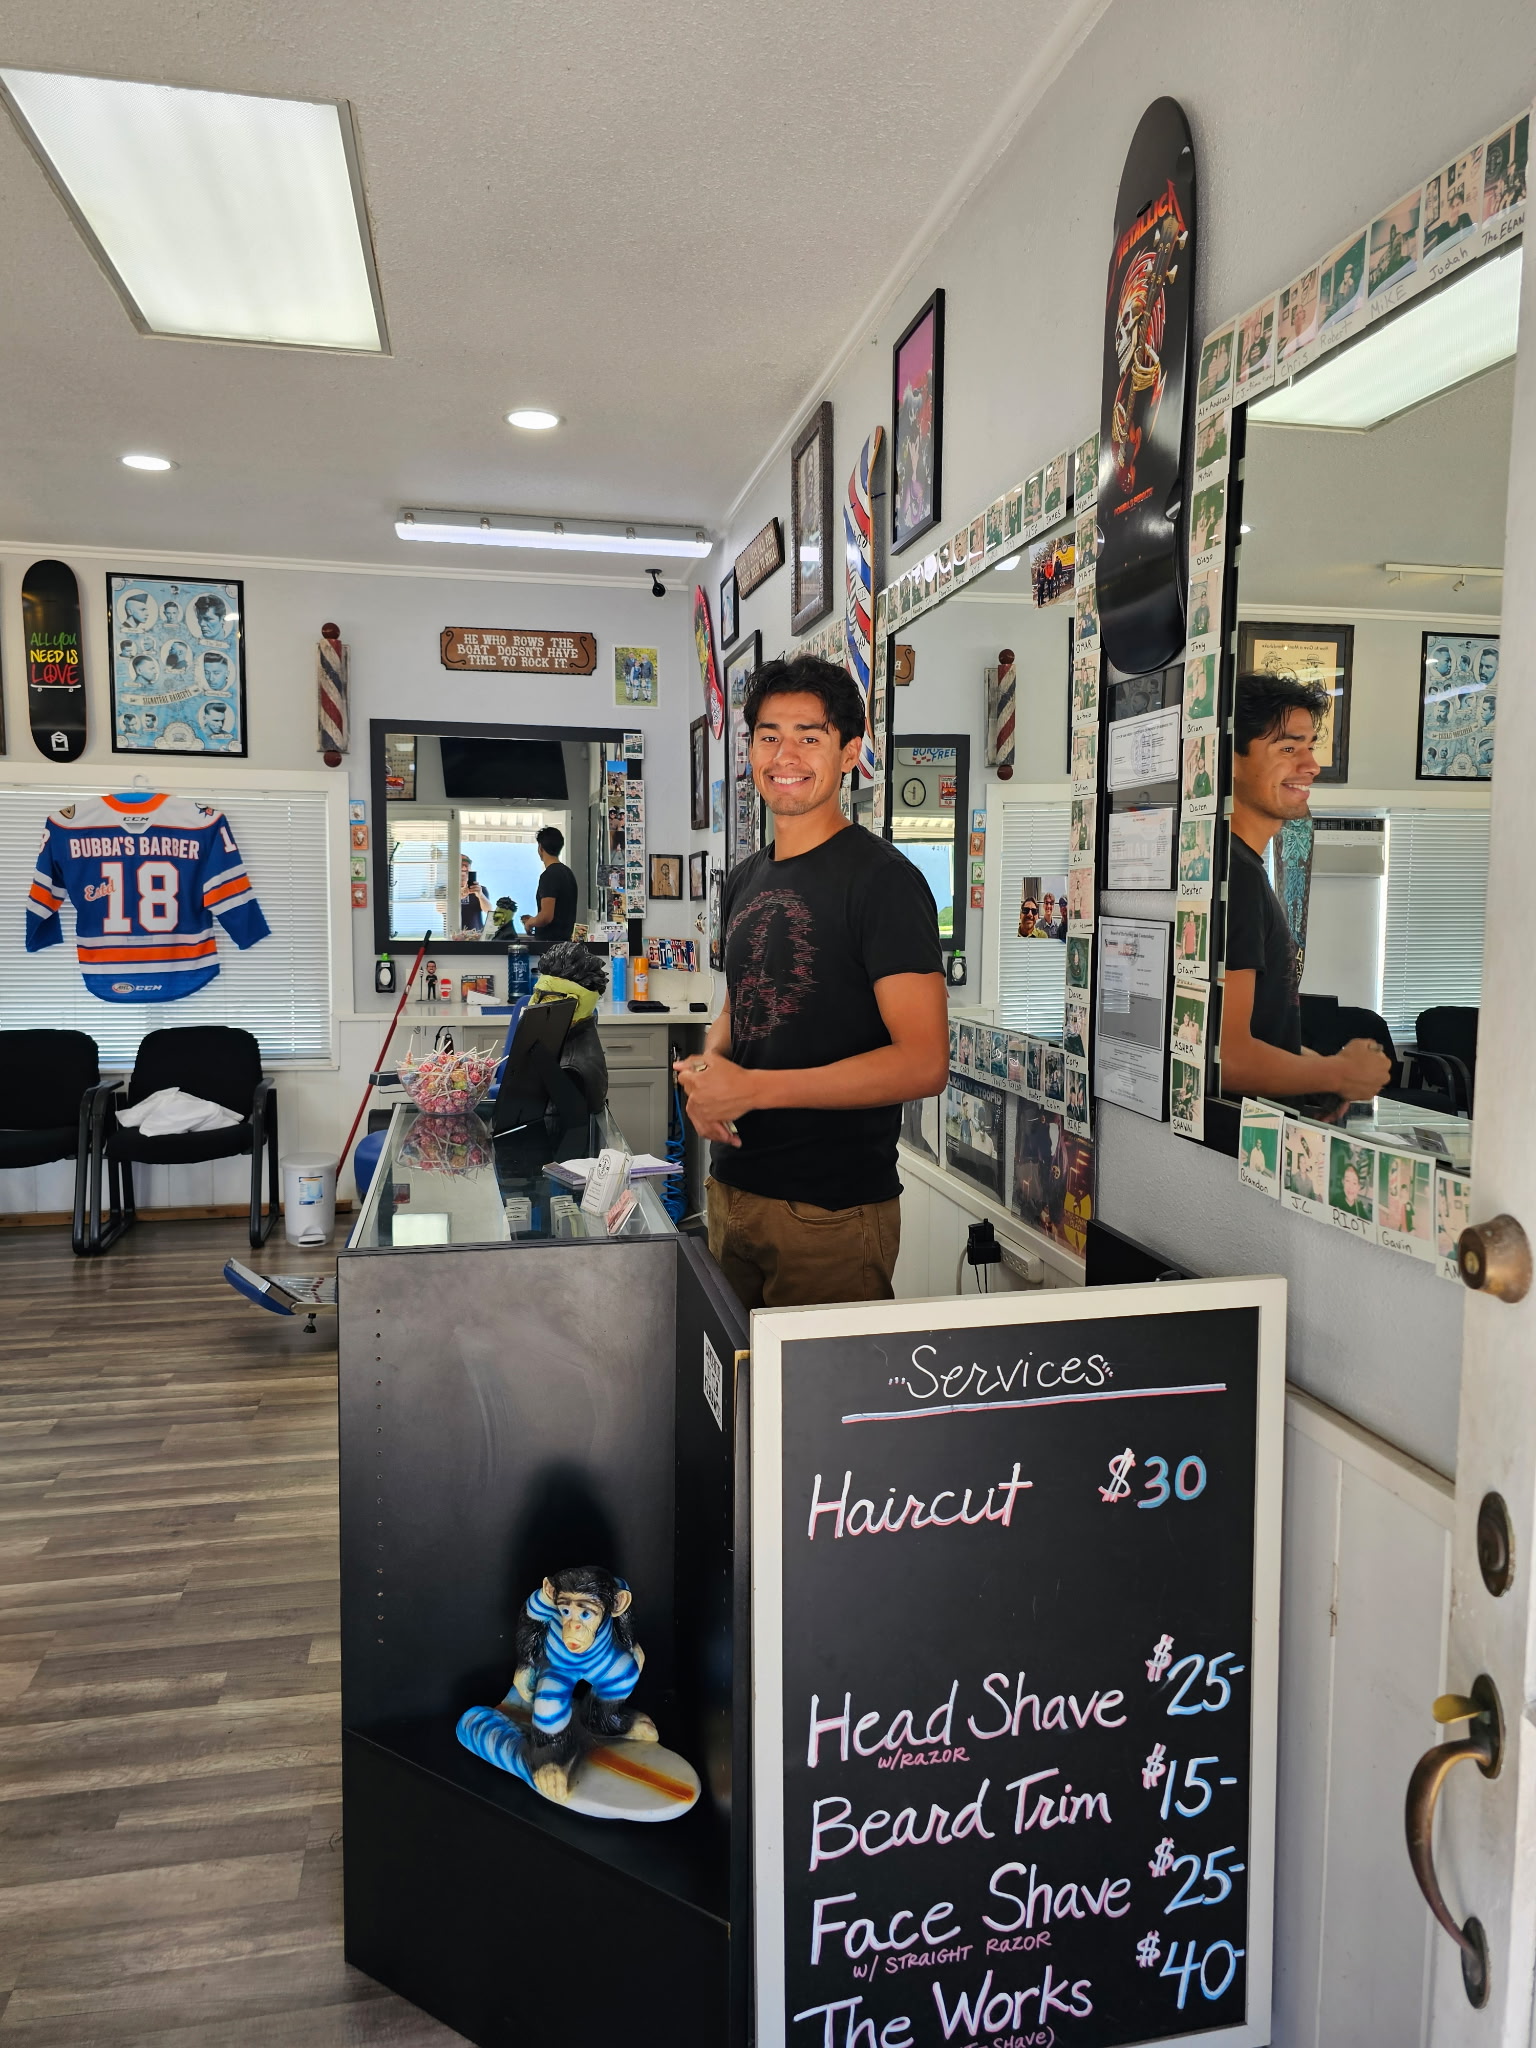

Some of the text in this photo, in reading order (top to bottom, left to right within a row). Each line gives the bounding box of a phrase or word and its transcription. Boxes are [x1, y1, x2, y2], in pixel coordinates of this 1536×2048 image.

[1428, 248, 1468, 282] Judah
[1319, 320, 1353, 349] Robert
[1046, 510, 1061, 525] JAMES
[30, 632, 51, 647] ALL
[457, 643, 579, 659] BOAT DOESN'T HAVE
[464, 633, 479, 646] HE
[482, 634, 507, 647] WHO
[550, 637, 574, 649] THE
[30, 649, 79, 665] NEED IS
[467, 654, 497, 667] TIME
[501, 656, 517, 667] TO
[521, 656, 550, 668] ROCK
[31, 663, 80, 685] LOVE
[69, 836, 199, 860] BUBBA'S BARBER
[84, 876, 115, 902] Estd
[101, 861, 179, 935] 18
[1177, 962, 1200, 975] Grant
[1174, 1039, 1195, 1057] ASHER
[1240, 1168, 1269, 1194] Brandon
[1332, 1208, 1371, 1235] RIOT
[1381, 1231, 1412, 1254] Gavin
[907, 1345, 1106, 1399] Services
[1098, 1447, 1207, 1509] $30
[808, 1462, 1033, 1540] Haircut
[806, 1671, 1128, 1768] Head Shave
[808, 1768, 1112, 1872] Beard Trim
[810, 1861, 1131, 1967] Face Shave
[793, 1965, 1093, 2048] The Works
